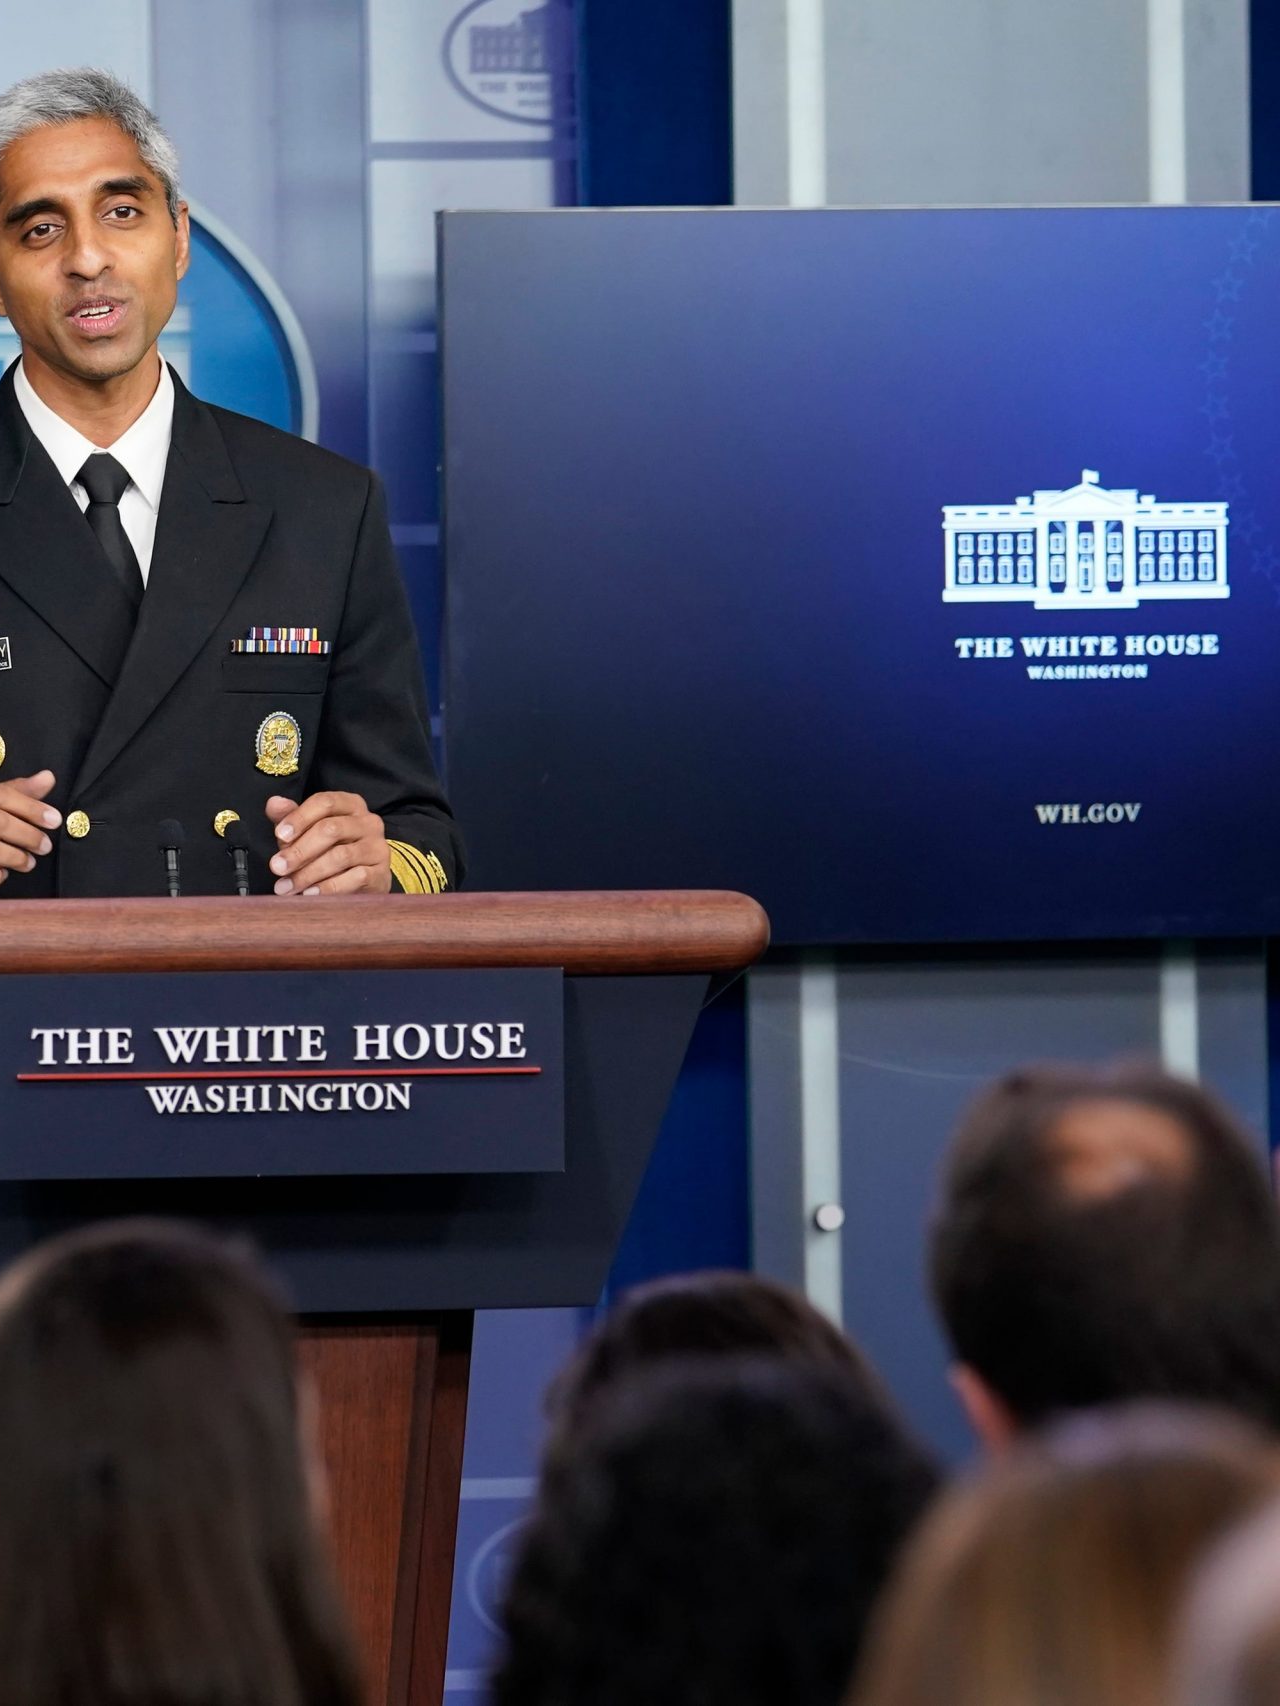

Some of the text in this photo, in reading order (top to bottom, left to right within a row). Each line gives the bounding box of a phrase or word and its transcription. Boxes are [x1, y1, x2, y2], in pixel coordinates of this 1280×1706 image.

[955, 634, 1220, 658] THE WHITE HOUSE
[1027, 664, 1148, 680] WASHINGTON
[1035, 803, 1141, 824] WH.GOV
[31, 1023, 527, 1065] THE WHITE HOUSE
[145, 1083, 412, 1114] WASHINGTON
